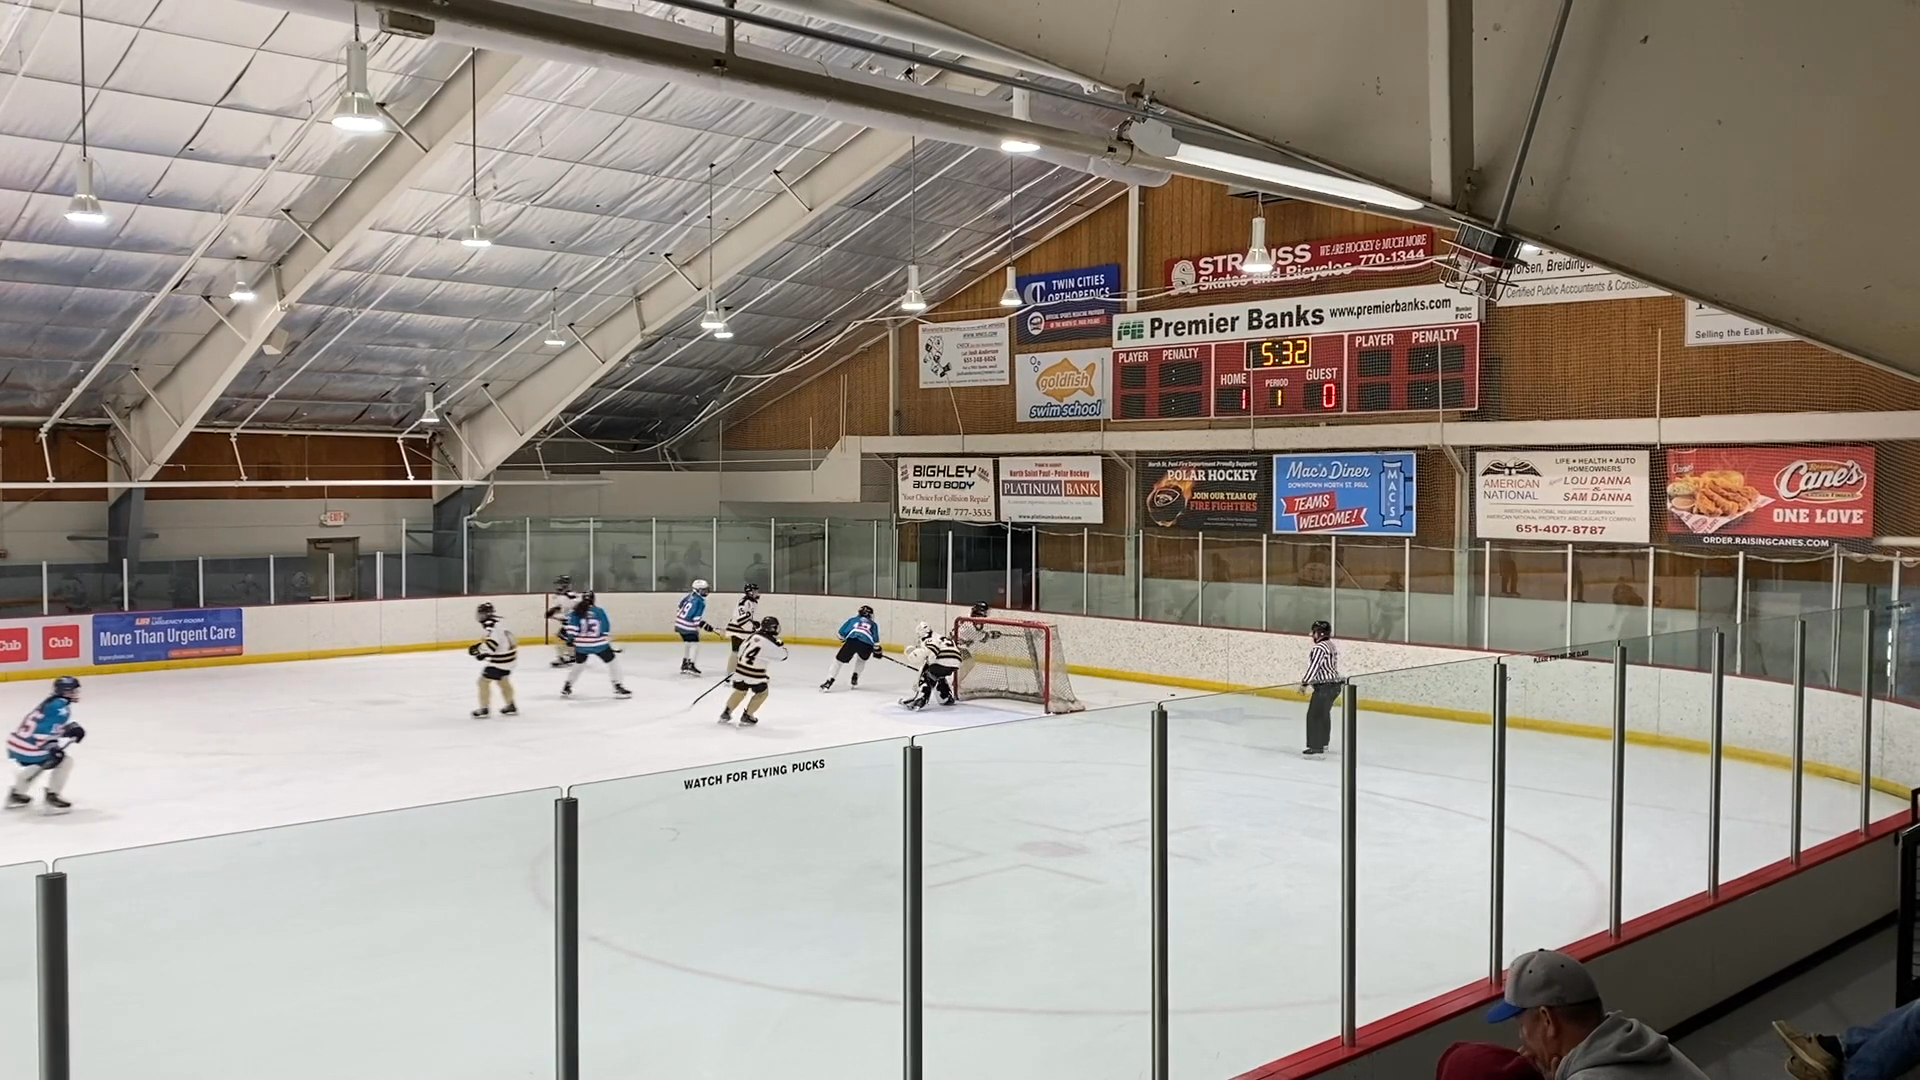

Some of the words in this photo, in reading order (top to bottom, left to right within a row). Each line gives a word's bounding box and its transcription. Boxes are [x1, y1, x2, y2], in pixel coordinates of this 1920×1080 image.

[1345, 240, 1375, 253] HOCKEY
[1375, 239, 1381, 250] &
[1382, 237, 1404, 249] MUCH
[1405, 234, 1427, 246] MORE
[1198, 244, 1312, 275] STRSS
[1359, 249, 1425, 266] 770-1344
[1052, 278, 1075, 290] TWIN
[1077, 274, 1105, 287] CITIES
[1506, 286, 1535, 298] Certified
[1537, 285, 1558, 296] Public
[1560, 283, 1605, 295] Accountants
[1607, 280, 1613, 291] &
[1048, 287, 1110, 302] ORTHOPEDICS
[1329, 297, 1451, 319] www.premierbanks.com
[1151, 313, 1240, 338] Premier
[1248, 305, 1325, 330] Banks
[1355, 334, 1394, 347] PLAYER
[1412, 329, 1459, 343] PENALTY
[1695, 330, 1724, 339] Selling
[1727, 329, 1741, 337] the
[1744, 328, 1764, 336] East
[1119, 351, 1149, 363] PLAYER
[1163, 348, 1199, 360] PENALTY
[1262, 340, 1307, 365] 5:32
[1040, 372, 1089, 391] goldfish
[1221, 373, 1247, 385] HOME
[1306, 368, 1338, 380] GUEST
[1265, 378, 1288, 387] PERIOD
[1277, 389, 1282, 406] 1
[1323, 383, 1335, 407] 0
[1030, 402, 1060, 418] swim
[1061, 399, 1102, 417] school
[913, 465, 977, 478] BIGHLEY
[1167, 470, 1206, 481] POLAR
[1208, 470, 1258, 481] HOCKEY
[1286, 461, 1327, 480] Mac's
[1329, 461, 1371, 480] Diner
[913, 481, 941, 489] AUTO
[943, 481, 976, 490] BODY
[1483, 478, 1540, 489] AMERICAN
[1563, 476, 1588, 485] LOU
[1590, 476, 1632, 485] DANNA
[1780, 460, 1864, 498] Cane's
[1004, 483, 1060, 494] PLATINUM
[1066, 483, 1099, 495] BANK
[1192, 492, 1209, 500] JOIN
[1210, 492, 1225, 500] OUR
[1226, 492, 1247, 500] TEAM
[1483, 490, 1539, 500] NATIONAL
[1563, 492, 1588, 501] SAM
[1591, 493, 1632, 501] DANNA
[944, 494, 968, 502] Collision
[1294, 494, 1330, 511] TEAMS
[953, 508, 992, 517] 777-3535
[1190, 501, 1210, 510] FIRE
[1212, 502, 1258, 511] FIGHTERS
[1299, 509, 1358, 529] WELCOME!
[1773, 509, 1809, 523] ONE
[1815, 509, 1864, 524] LOVE
[1516, 524, 1606, 535] 651-407-8787
[1703, 536, 1830, 547] ORDER.RAISINGCANES.COM
[48, 637, 74, 648] Cub
[100, 631, 132, 646] More
[134, 629, 164, 644] Than
[167, 627, 208, 645] Urgent
[209, 626, 236, 640] Care
[684, 775, 722, 790] WATCH
[726, 771, 748, 784] FOR
[751, 765, 788, 780] FLYING
[792, 759, 825, 774] PUCKS
